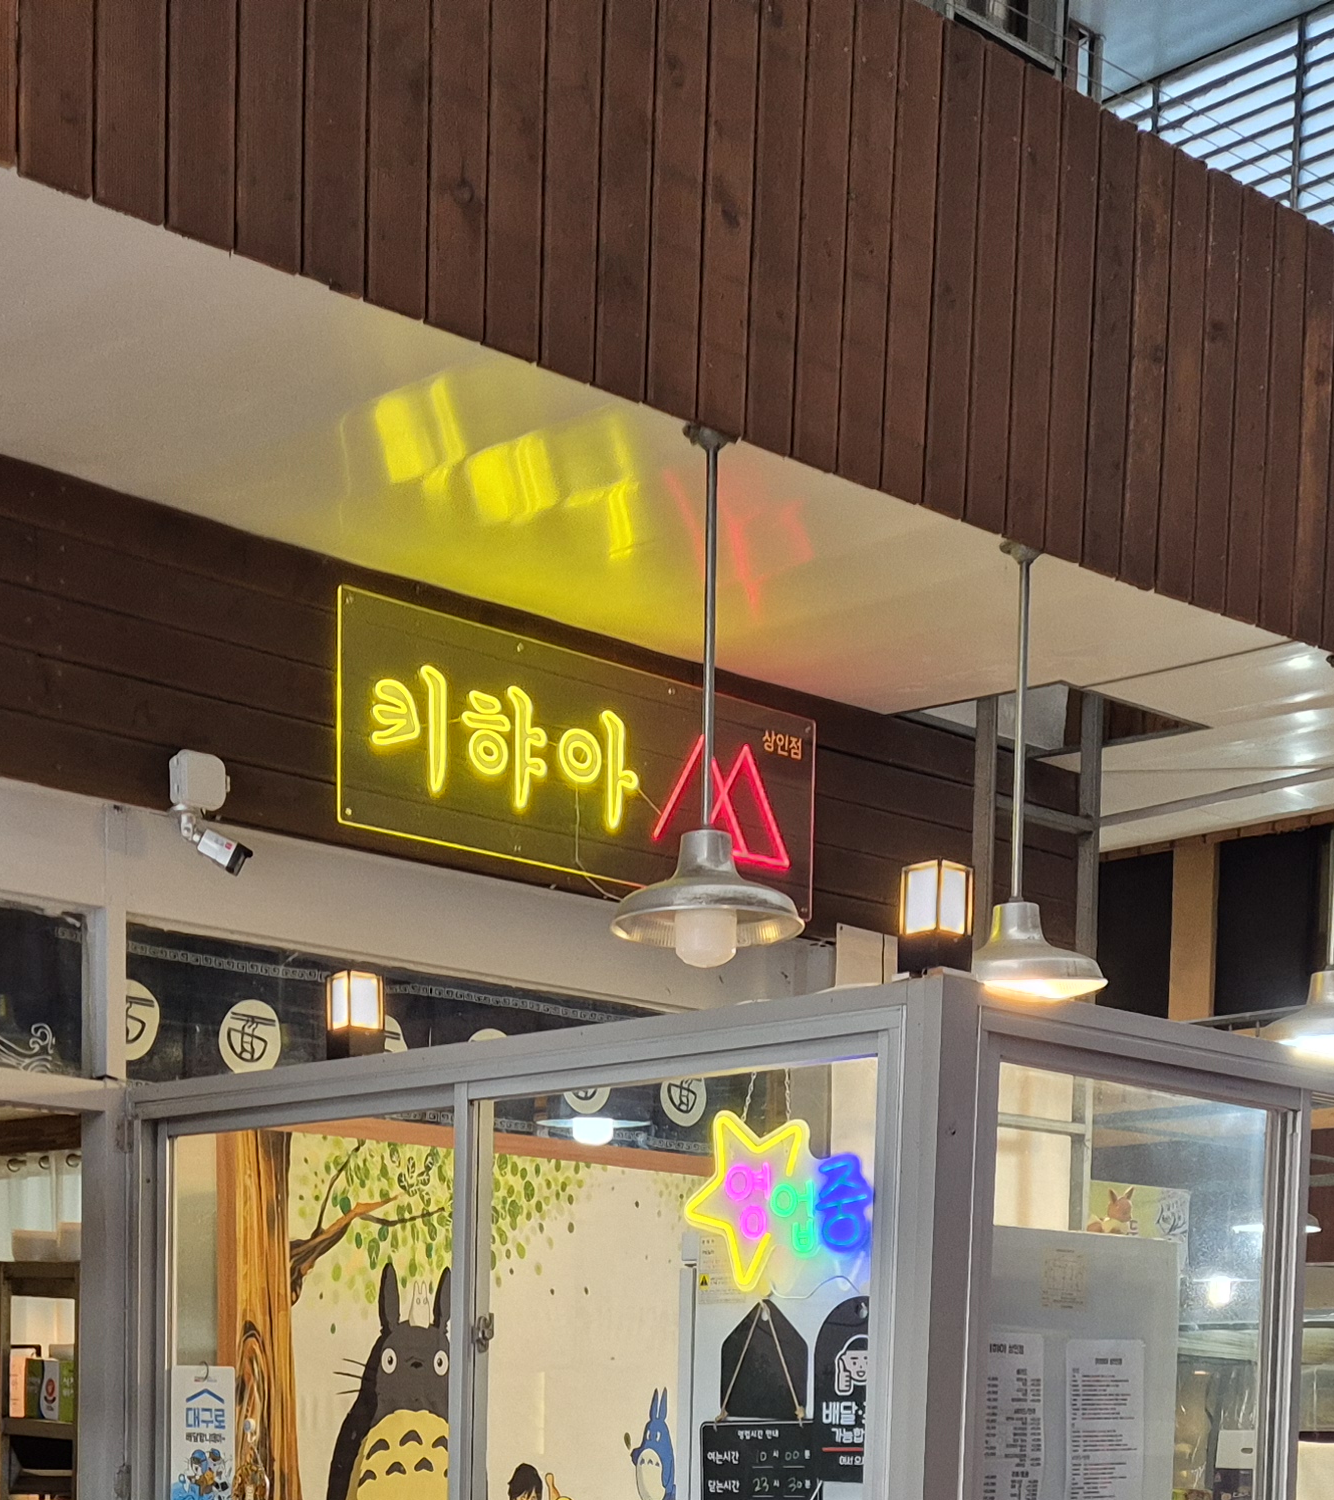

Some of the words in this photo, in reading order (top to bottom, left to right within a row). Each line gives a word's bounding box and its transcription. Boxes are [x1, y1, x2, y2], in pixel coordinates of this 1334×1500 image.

[370, 664, 640, 831] 키햐아
[762, 729, 803, 761] 상인점
[725, 1160, 869, 1255] 영업중
[185, 1407, 226, 1430] 대구로
[822, 1401, 866, 1425] 배달·
[765, 1429, 780, 1439] 안내
[707, 1451, 740, 1465] 여는시간
[707, 1479, 740, 1493] 닫는시간
[752, 1477, 769, 1493] 23
[788, 1477, 803, 1491] 30
